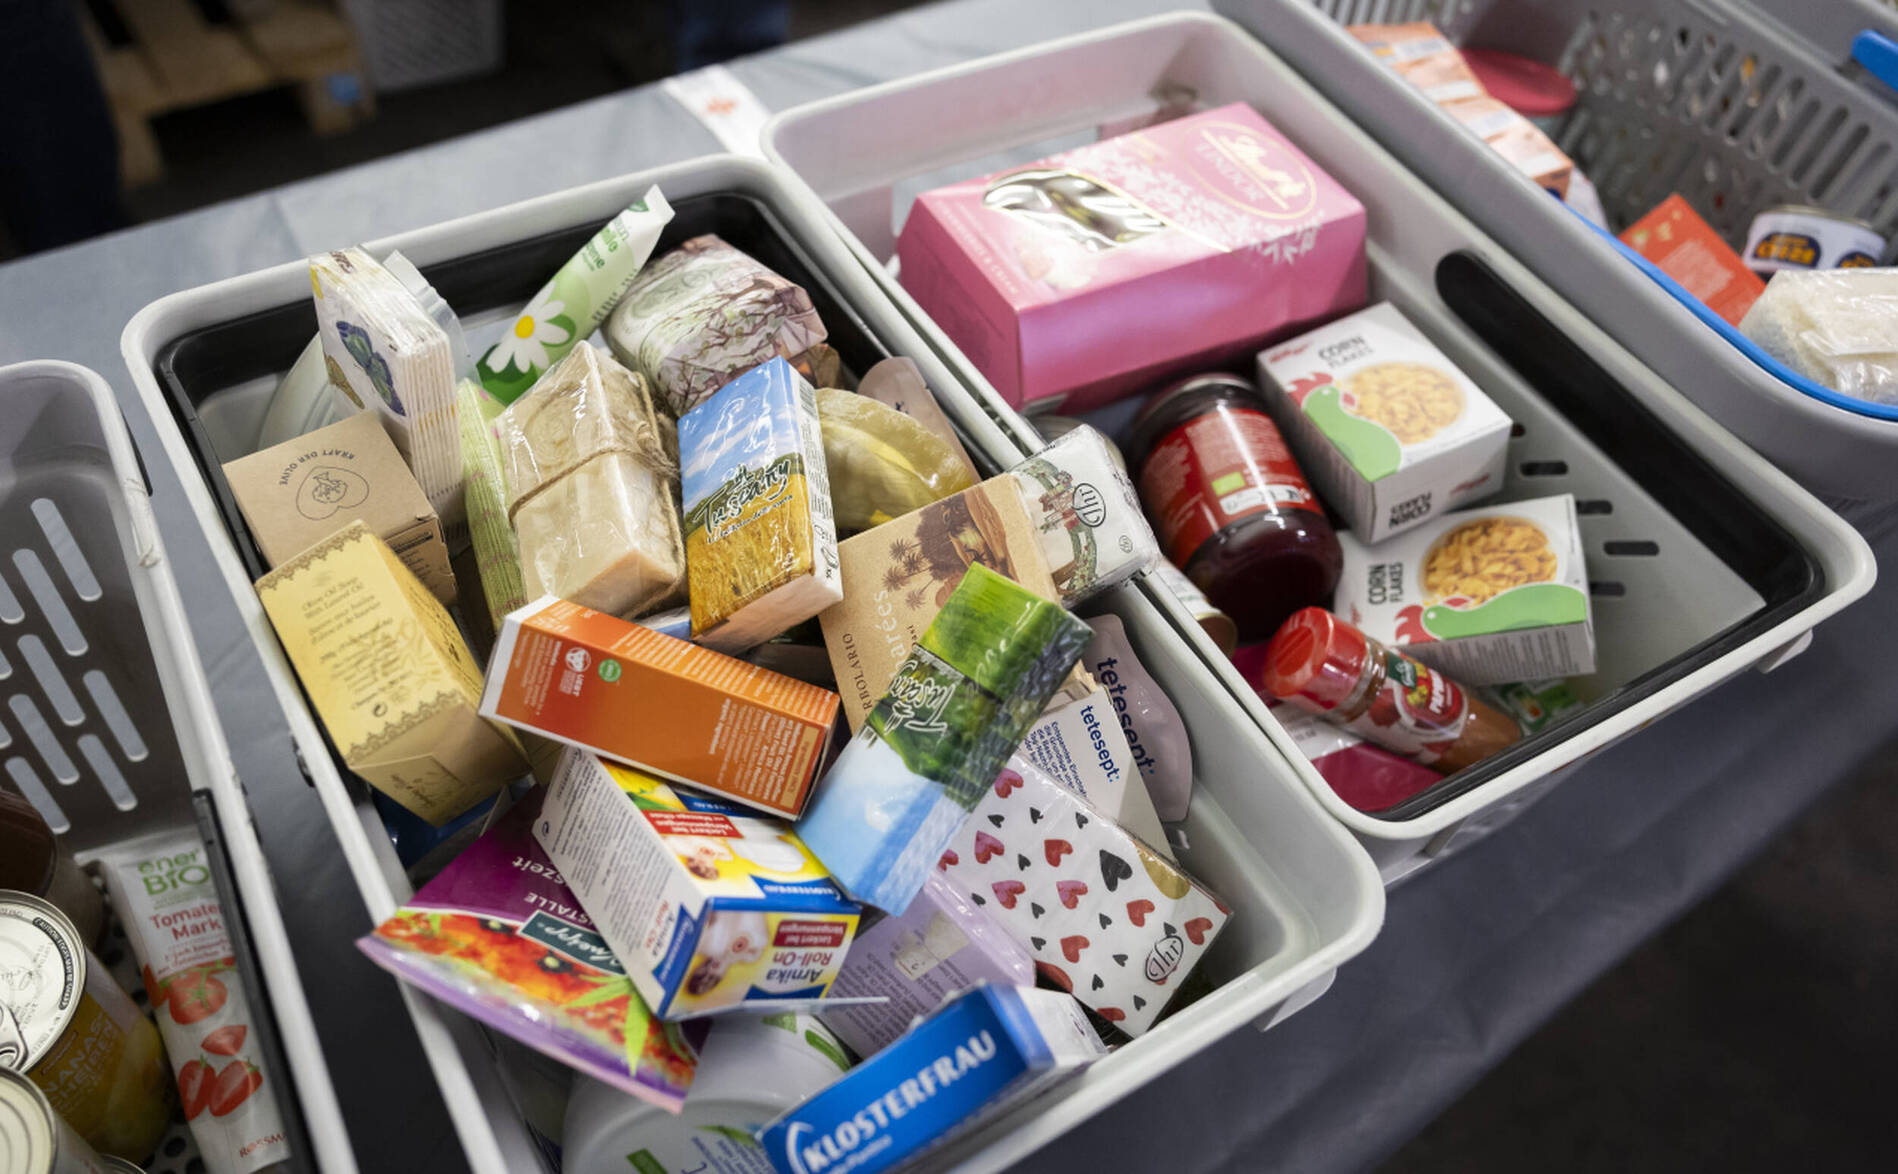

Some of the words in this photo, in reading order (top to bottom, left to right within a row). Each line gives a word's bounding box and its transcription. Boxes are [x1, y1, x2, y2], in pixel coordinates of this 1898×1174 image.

[1318, 336, 1365, 360] CORN
[297, 451, 318, 463] DER
[322, 449, 355, 460] KRAFT
[279, 462, 298, 486] OLIVE
[692, 459, 790, 534] Tuscany
[1389, 502, 1432, 528] CORN
[1368, 563, 1386, 605] CORN
[1389, 562, 1403, 603] FLAKES
[843, 633, 871, 712] RBOLARIO
[171, 919, 223, 941] Mark
[779, 924, 844, 934] Verspannungen
[785, 936, 801, 944] bei
[802, 936, 832, 944] Lockert
[773, 951, 832, 965] Roll-On
[766, 968, 823, 982] Arnika
[802, 1030, 997, 1174] KLOSTERFRAU
